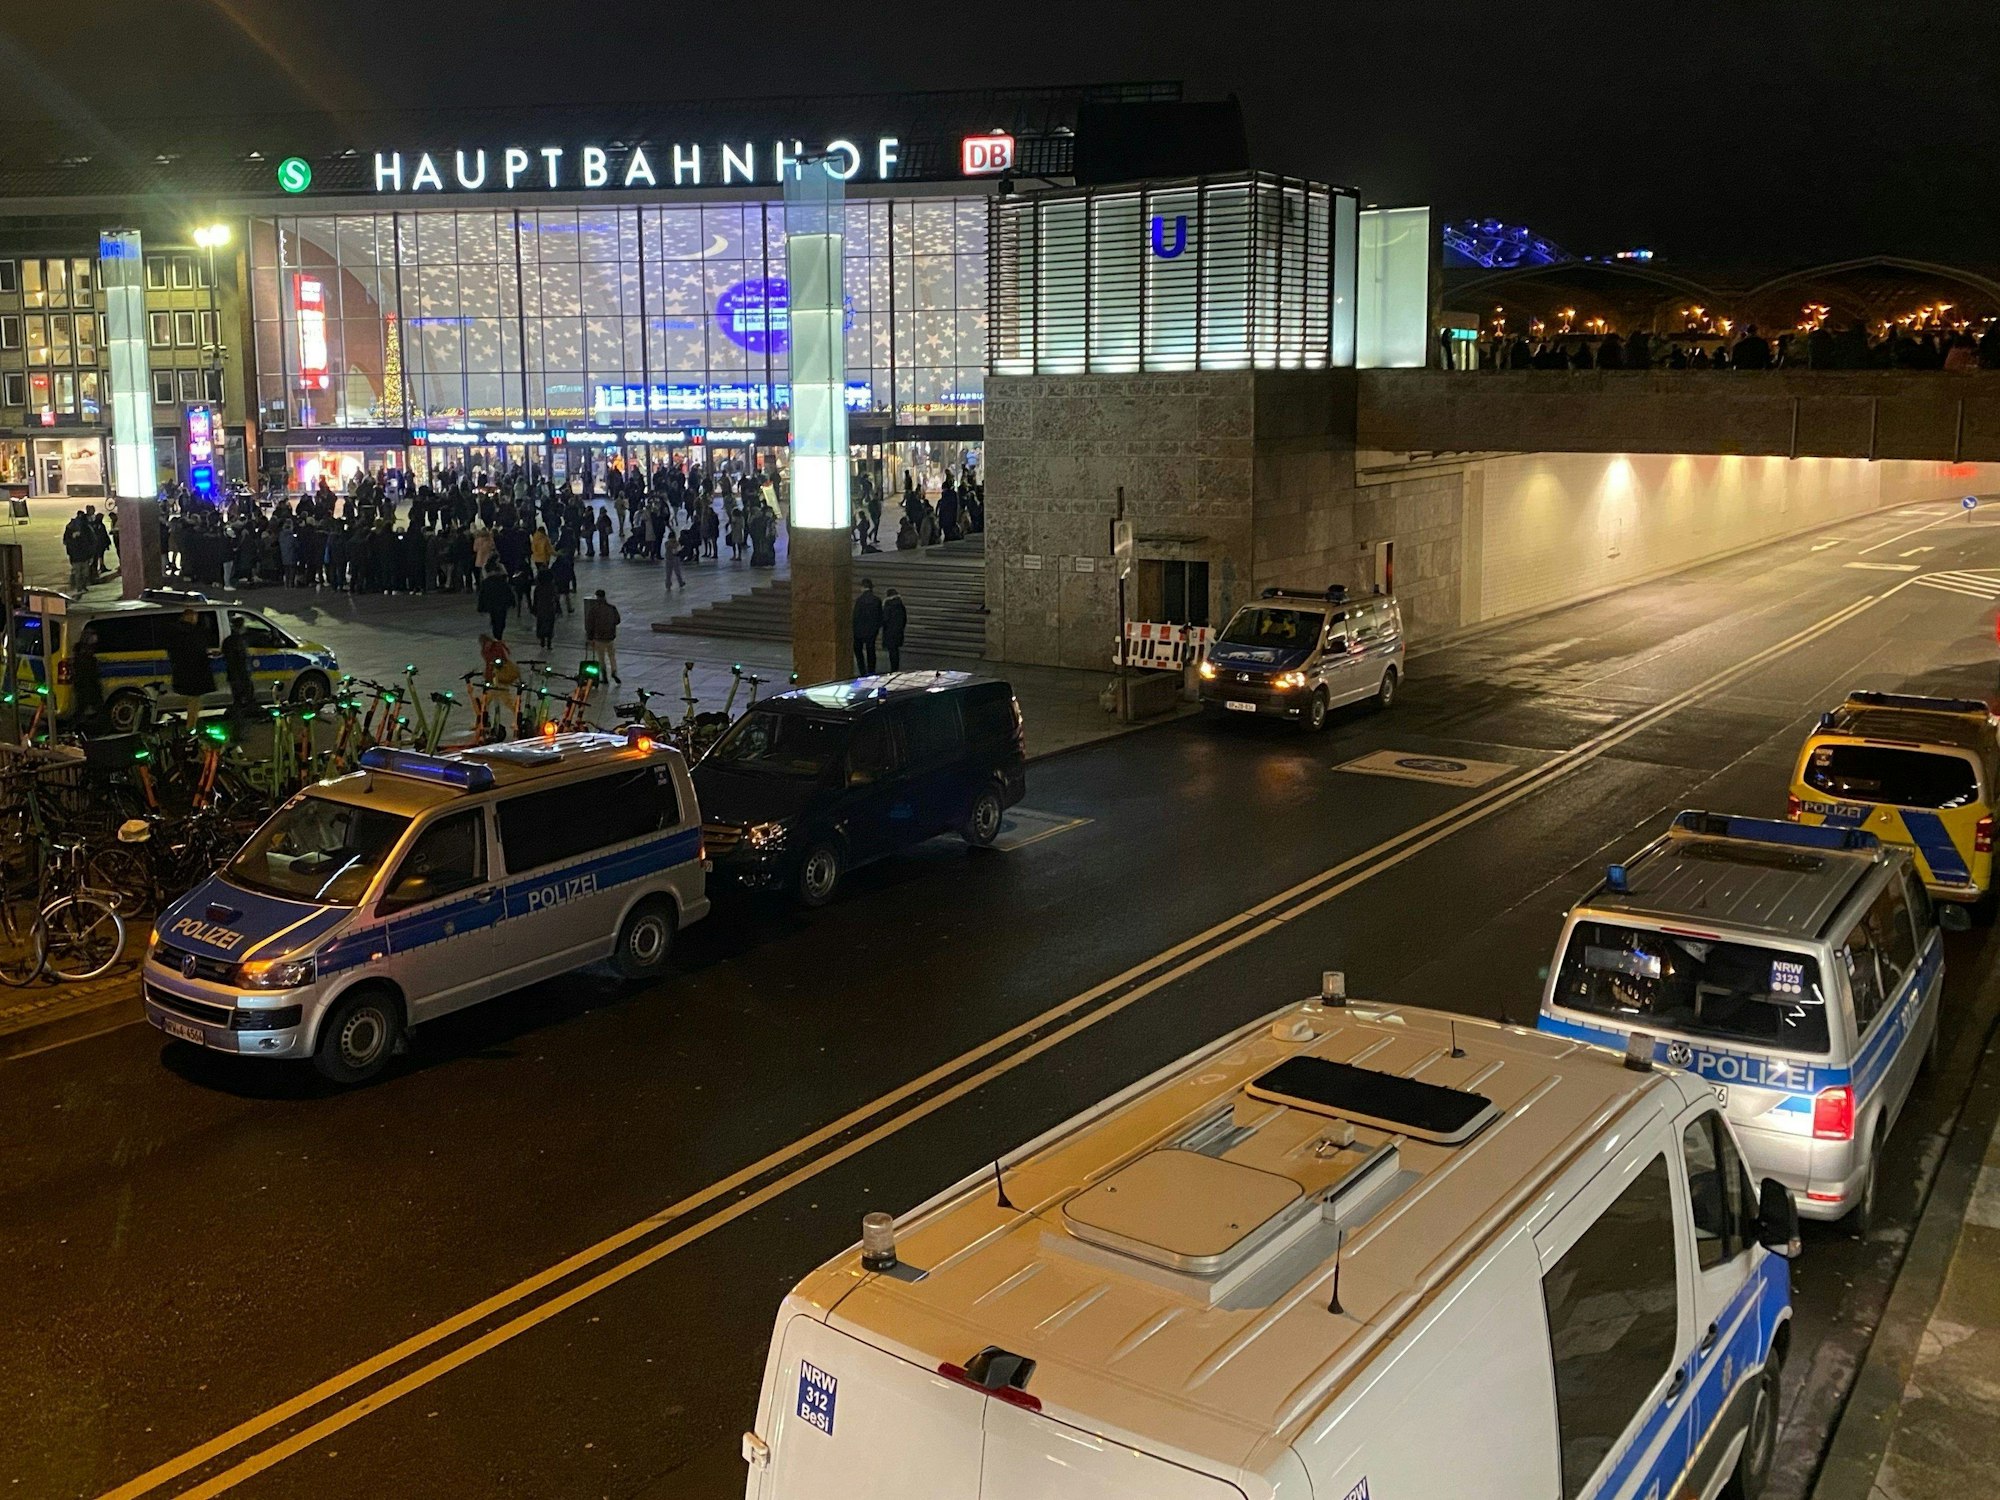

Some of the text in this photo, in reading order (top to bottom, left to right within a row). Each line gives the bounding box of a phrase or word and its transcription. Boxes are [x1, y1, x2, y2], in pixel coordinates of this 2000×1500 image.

[372, 137, 902, 192] HAUPTBAHNHOF
[970, 143, 1007, 168] DB
[283, 160, 306, 189] S
[1152, 215, 1187, 258] U
[949, 392, 985, 401] STARBU
[1804, 801, 1862, 818] POLIZEI
[527, 872, 598, 912] POLIZEI
[171, 918, 245, 950] POLIZEI
[1773, 960, 1804, 975] NRW
[1775, 972, 1800, 985] 3123
[1697, 1051, 1815, 1092] POLIZEI
[801, 1361, 836, 1395] NRW
[805, 1386, 828, 1412] 312
[800, 1402, 829, 1432] BeSi
[1346, 1478, 1367, 1500] RW
